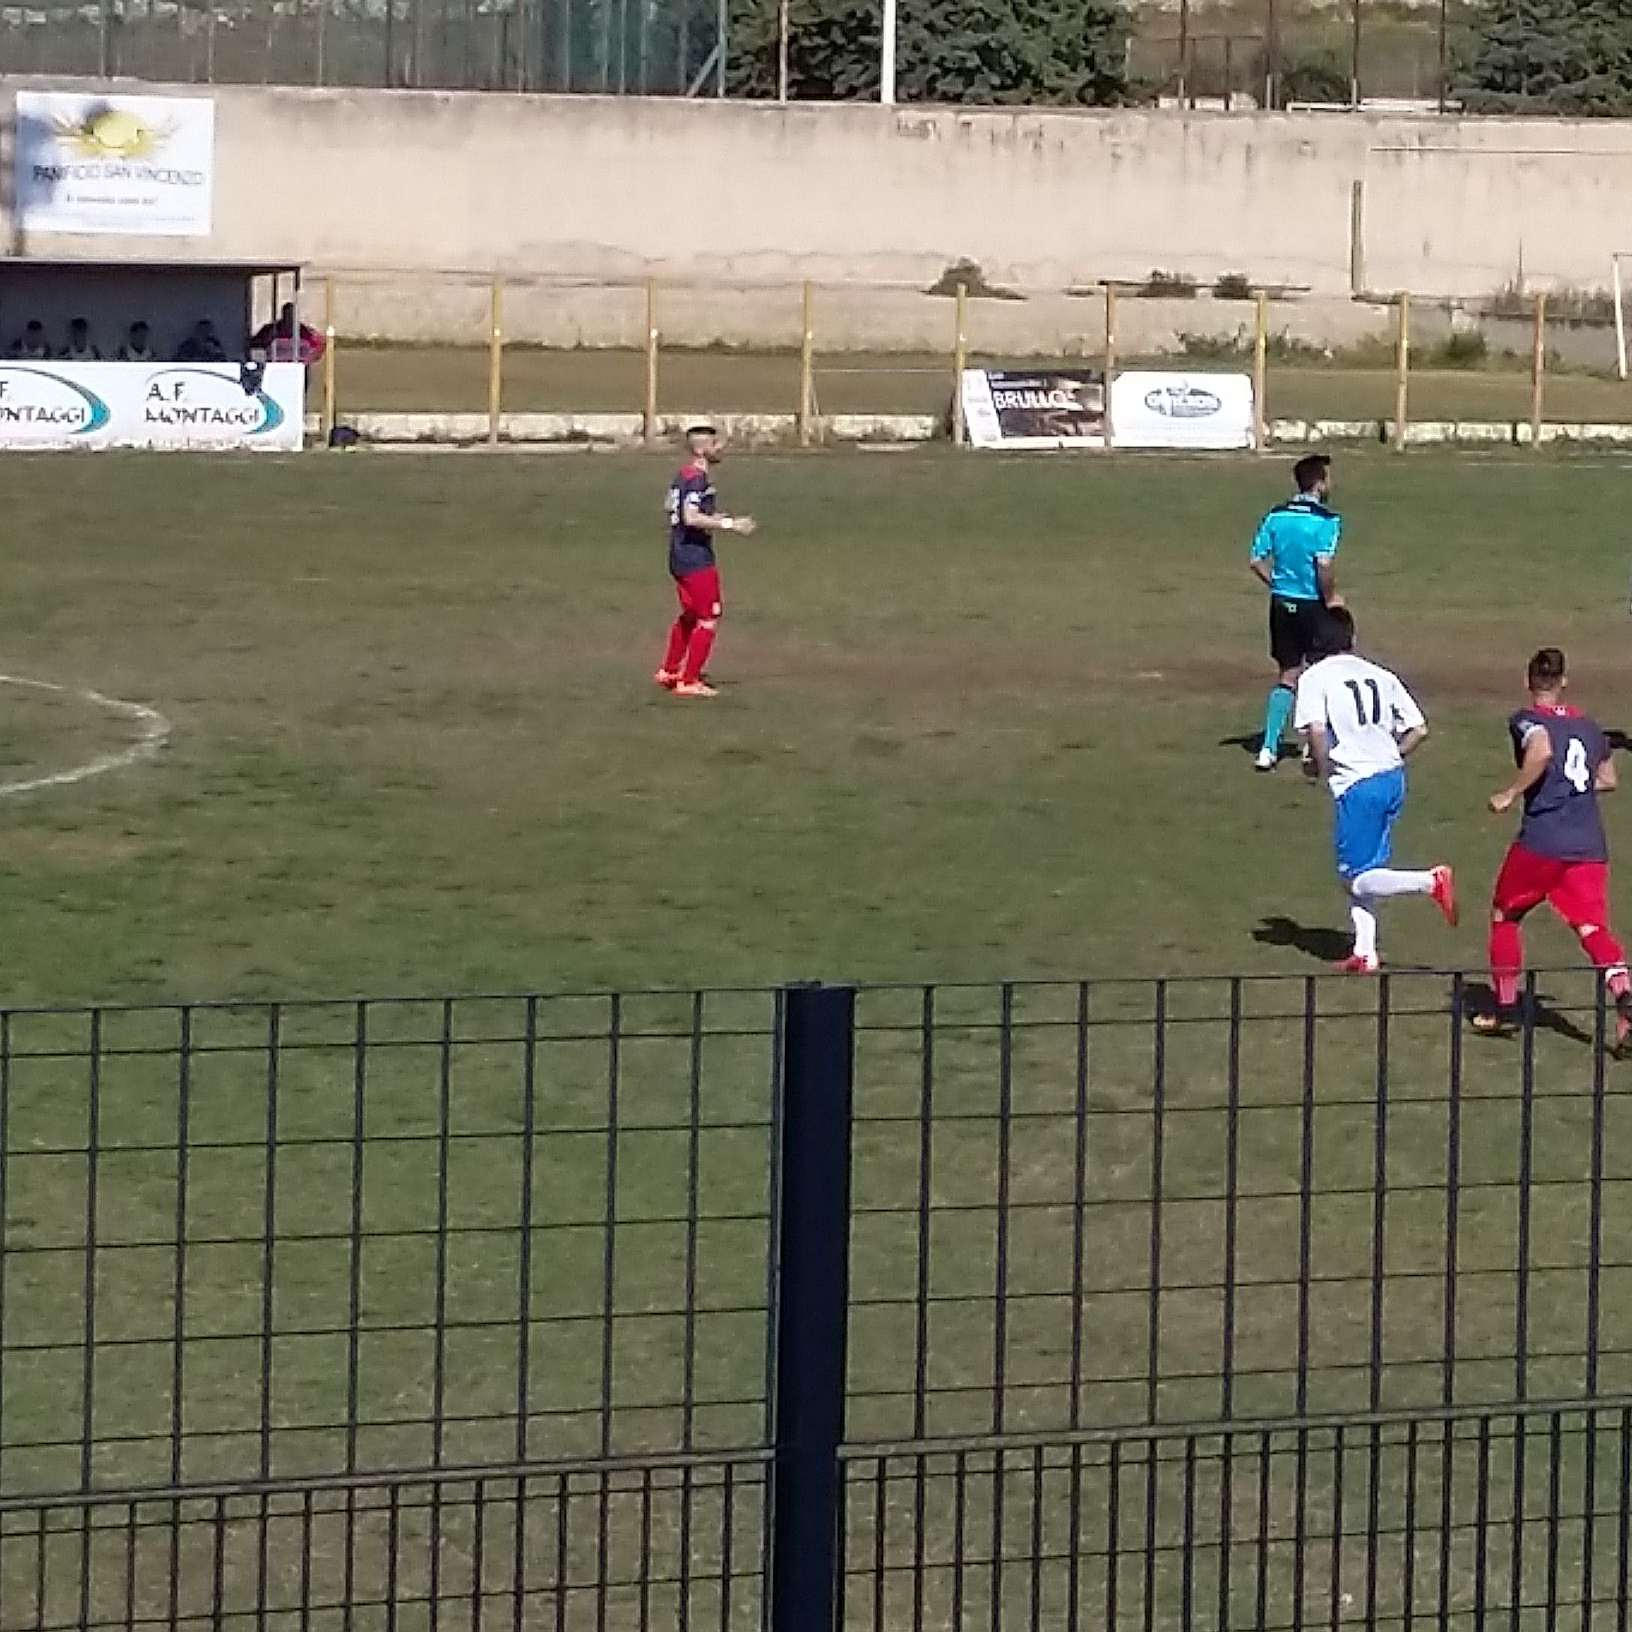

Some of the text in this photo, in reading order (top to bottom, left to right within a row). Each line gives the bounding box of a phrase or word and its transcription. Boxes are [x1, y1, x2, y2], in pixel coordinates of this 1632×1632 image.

[146, 406, 259, 424] MONTAGGI
[1343, 678, 1381, 726] 11
[1562, 737, 1592, 794] 4
